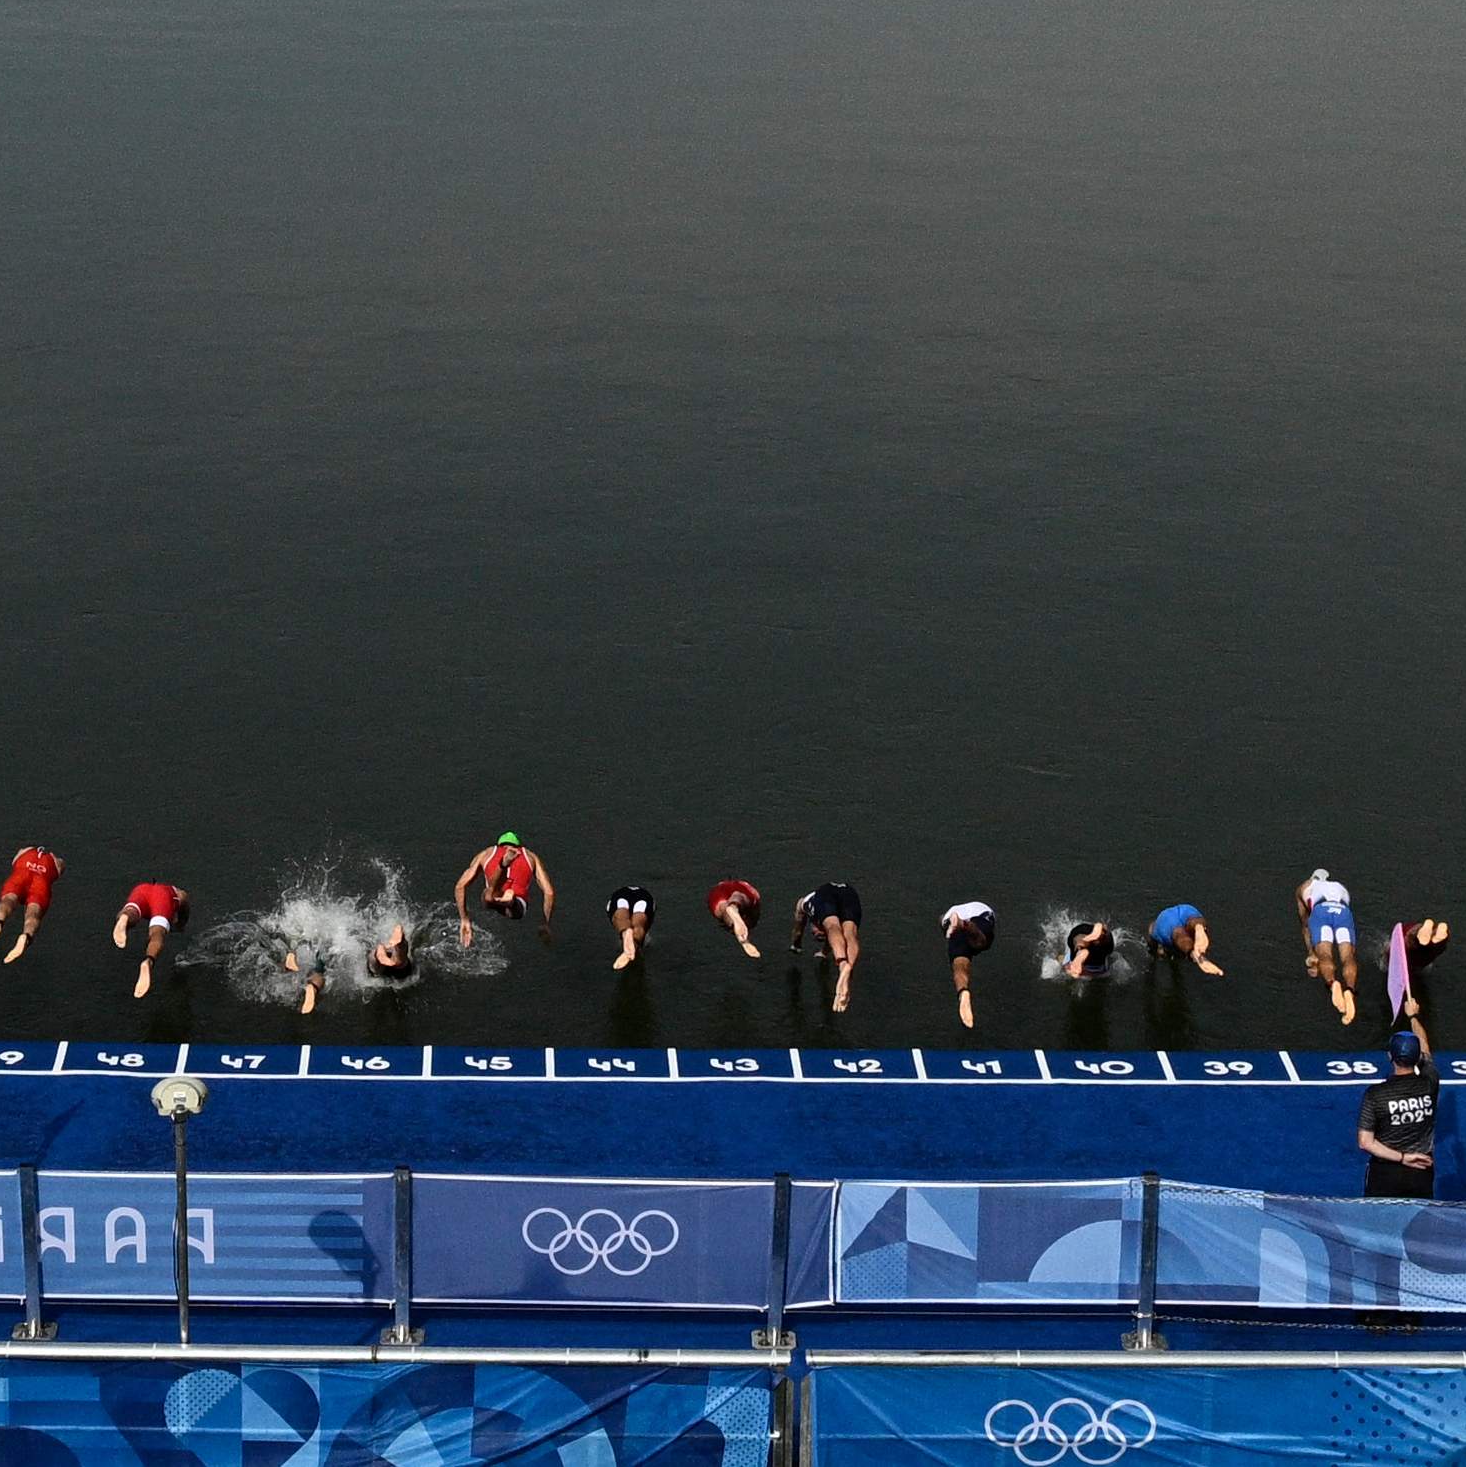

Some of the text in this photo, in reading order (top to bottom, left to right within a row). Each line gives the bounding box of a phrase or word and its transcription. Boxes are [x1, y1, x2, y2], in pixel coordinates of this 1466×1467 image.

[96, 1051, 145, 1068] 48
[220, 1054, 267, 1069] 47
[340, 1055, 391, 1071] 46
[464, 1055, 513, 1071] 45
[587, 1057, 636, 1072] 44
[709, 1057, 760, 1072] 43
[833, 1058, 884, 1074] 42
[961, 1059, 1003, 1075] 41
[1074, 1060, 1135, 1075] 40
[1203, 1060, 1254, 1076] 39
[1326, 1060, 1379, 1076] 38
[1388, 1095, 1432, 1114] PARIS
